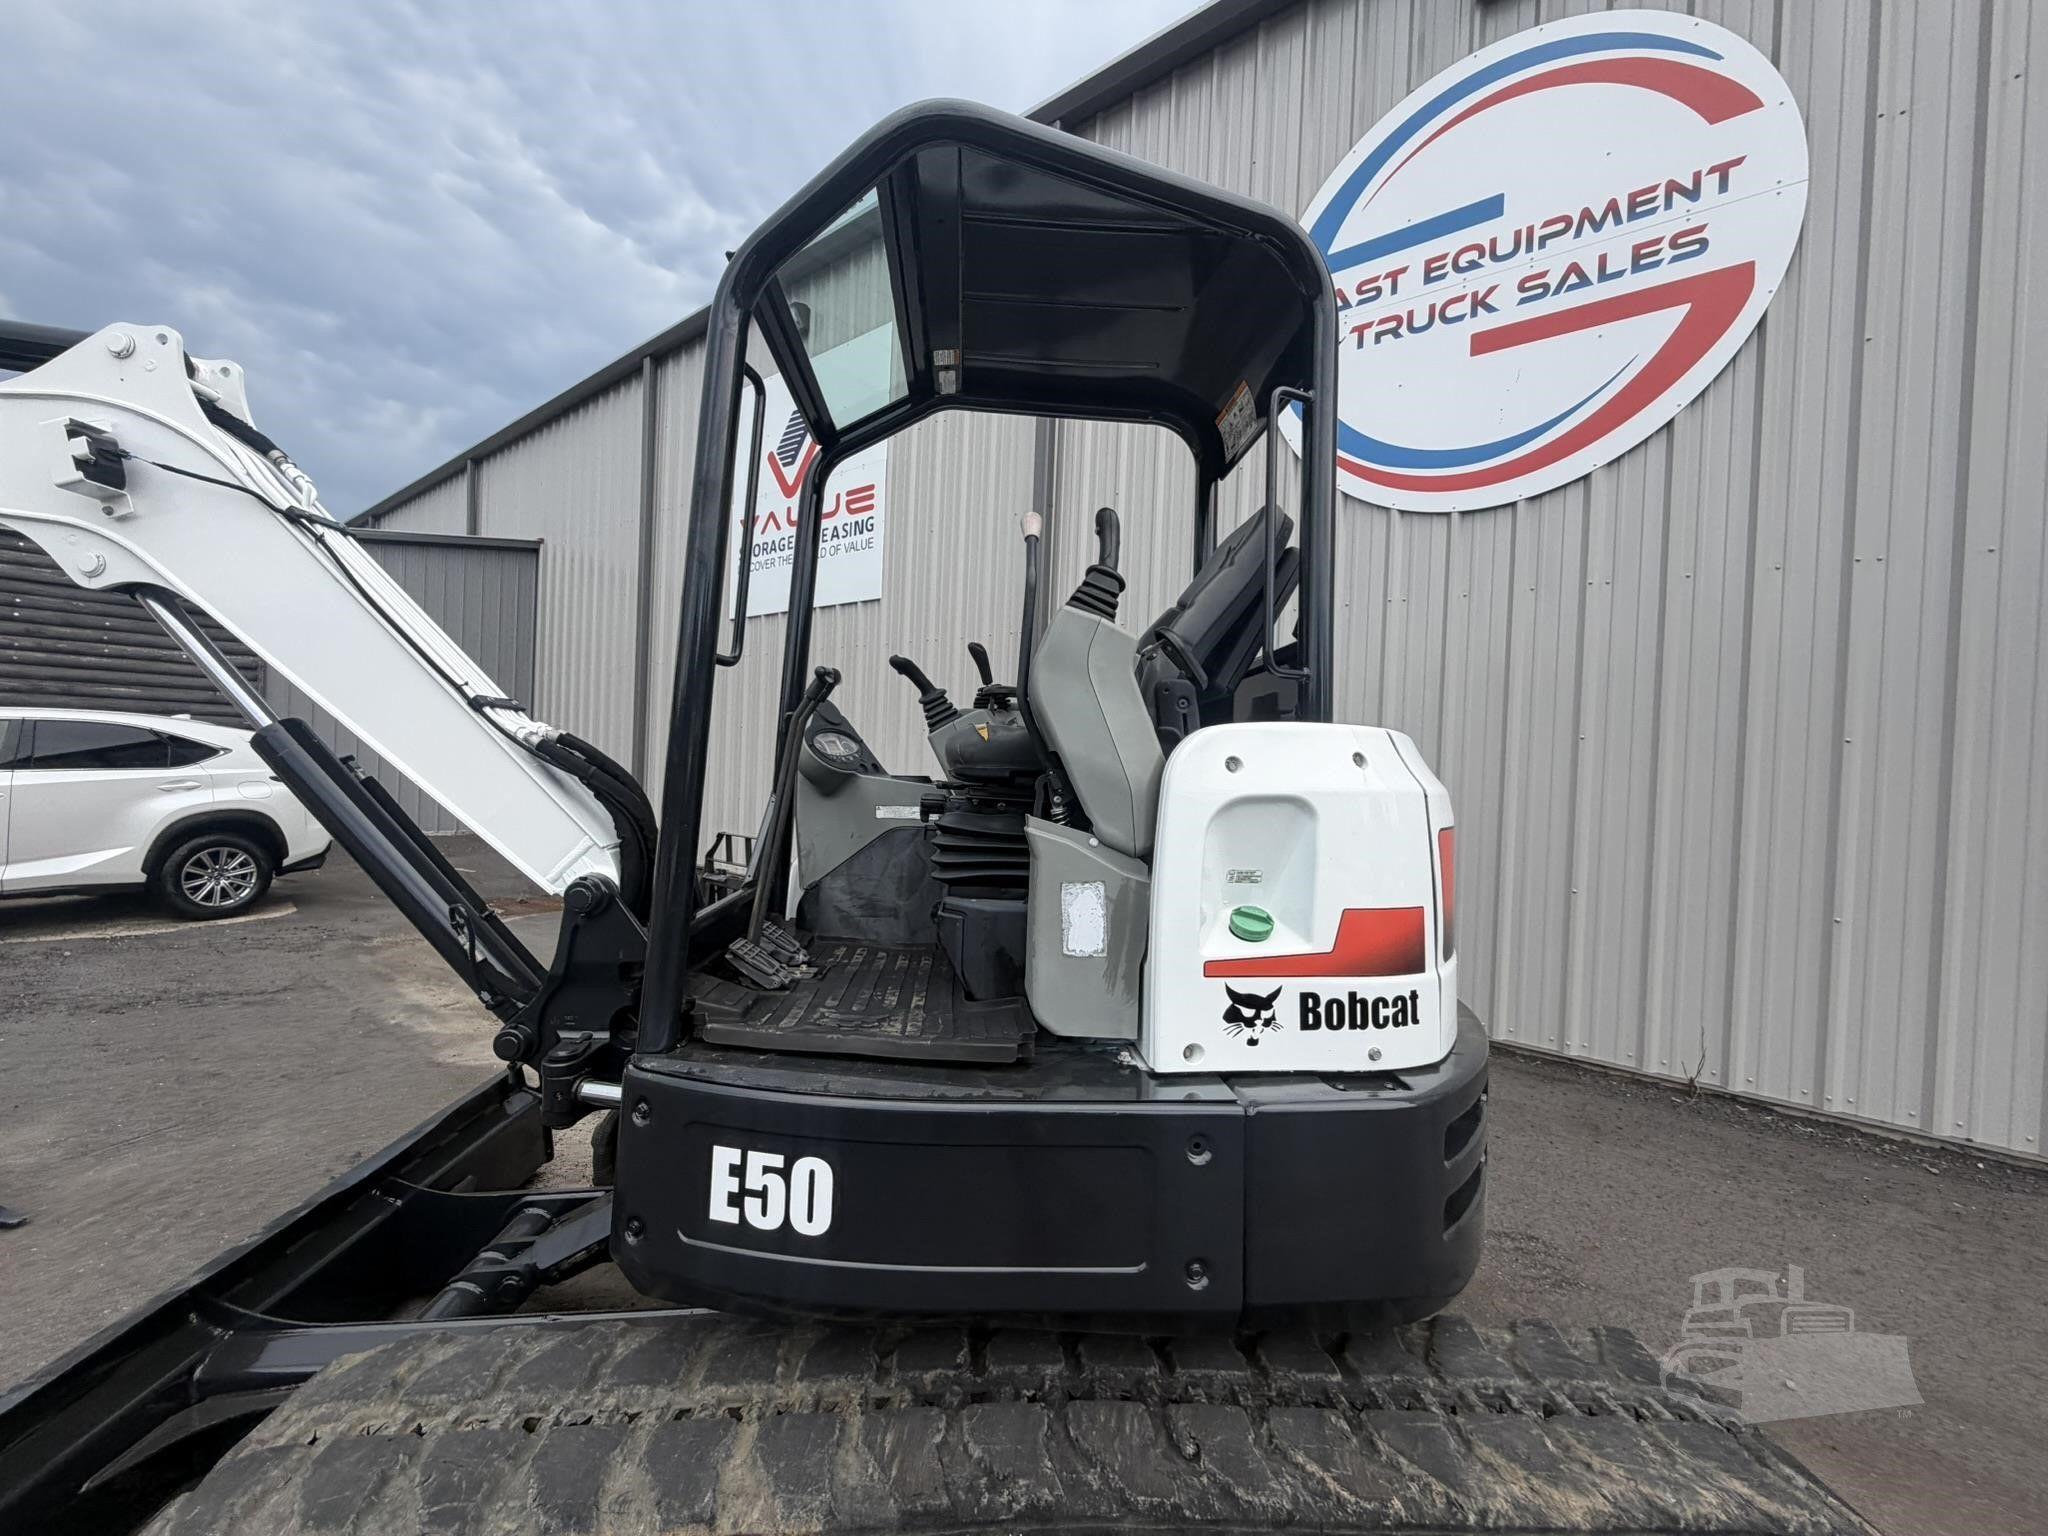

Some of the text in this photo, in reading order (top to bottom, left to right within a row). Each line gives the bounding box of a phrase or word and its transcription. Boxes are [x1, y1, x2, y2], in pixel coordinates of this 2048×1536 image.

[1336, 155, 1747, 312] AST EQUIPMENT
[1349, 223, 1709, 350] TRUCK SALES
[750, 535, 795, 558] ORAGE
[821, 516, 875, 543] EASING
[750, 557, 776, 572] COVER
[829, 543, 842, 557] OF
[843, 537, 874, 554] VALUE
[1299, 989, 1420, 1031] Bobcat
[709, 1145, 834, 1237] E50
